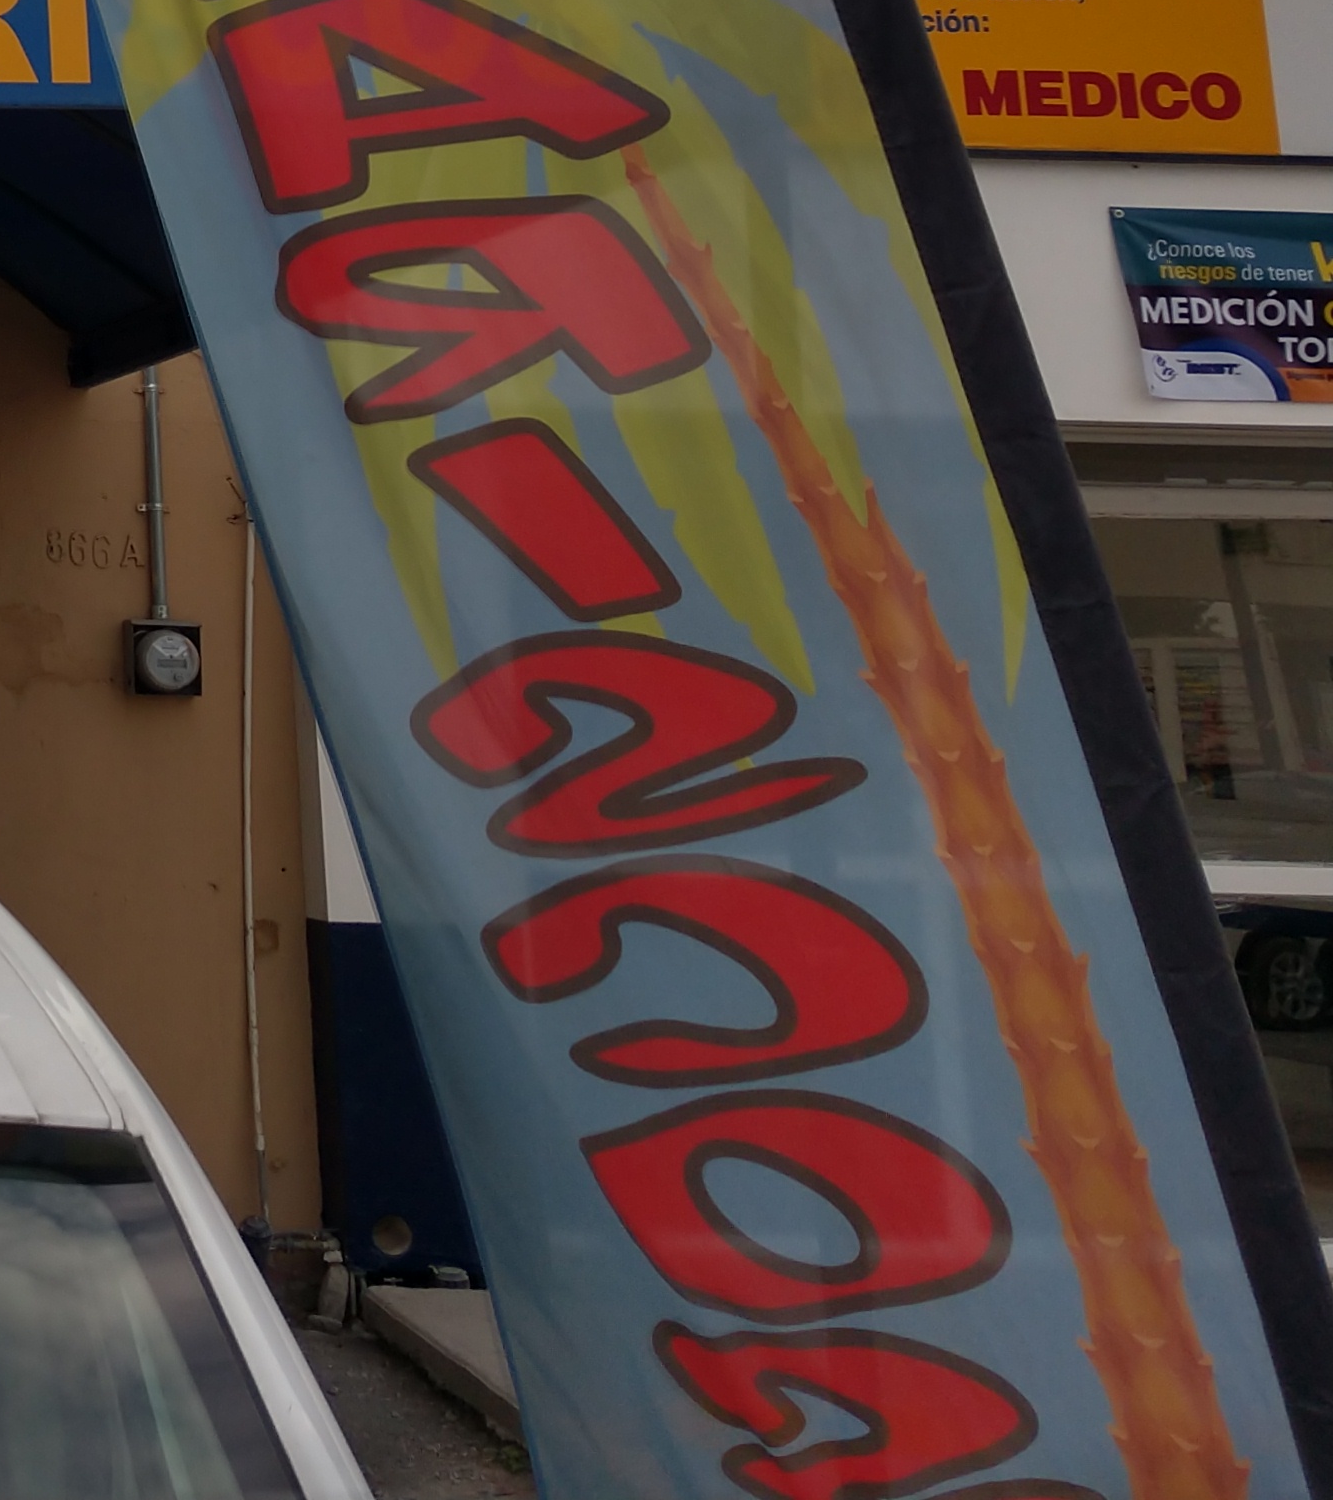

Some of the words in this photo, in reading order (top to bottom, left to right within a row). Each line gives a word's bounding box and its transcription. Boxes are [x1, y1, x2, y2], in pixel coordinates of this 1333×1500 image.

[962, 68, 1243, 121] MEDICO
[1227, 242, 1257, 259] los
[1159, 258, 1238, 285] riesgos
[1240, 263, 1265, 281] de
[1267, 265, 1315, 281] tener
[1139, 289, 1315, 327] MEDICIÓN
[1277, 336, 1333, 364] TO
